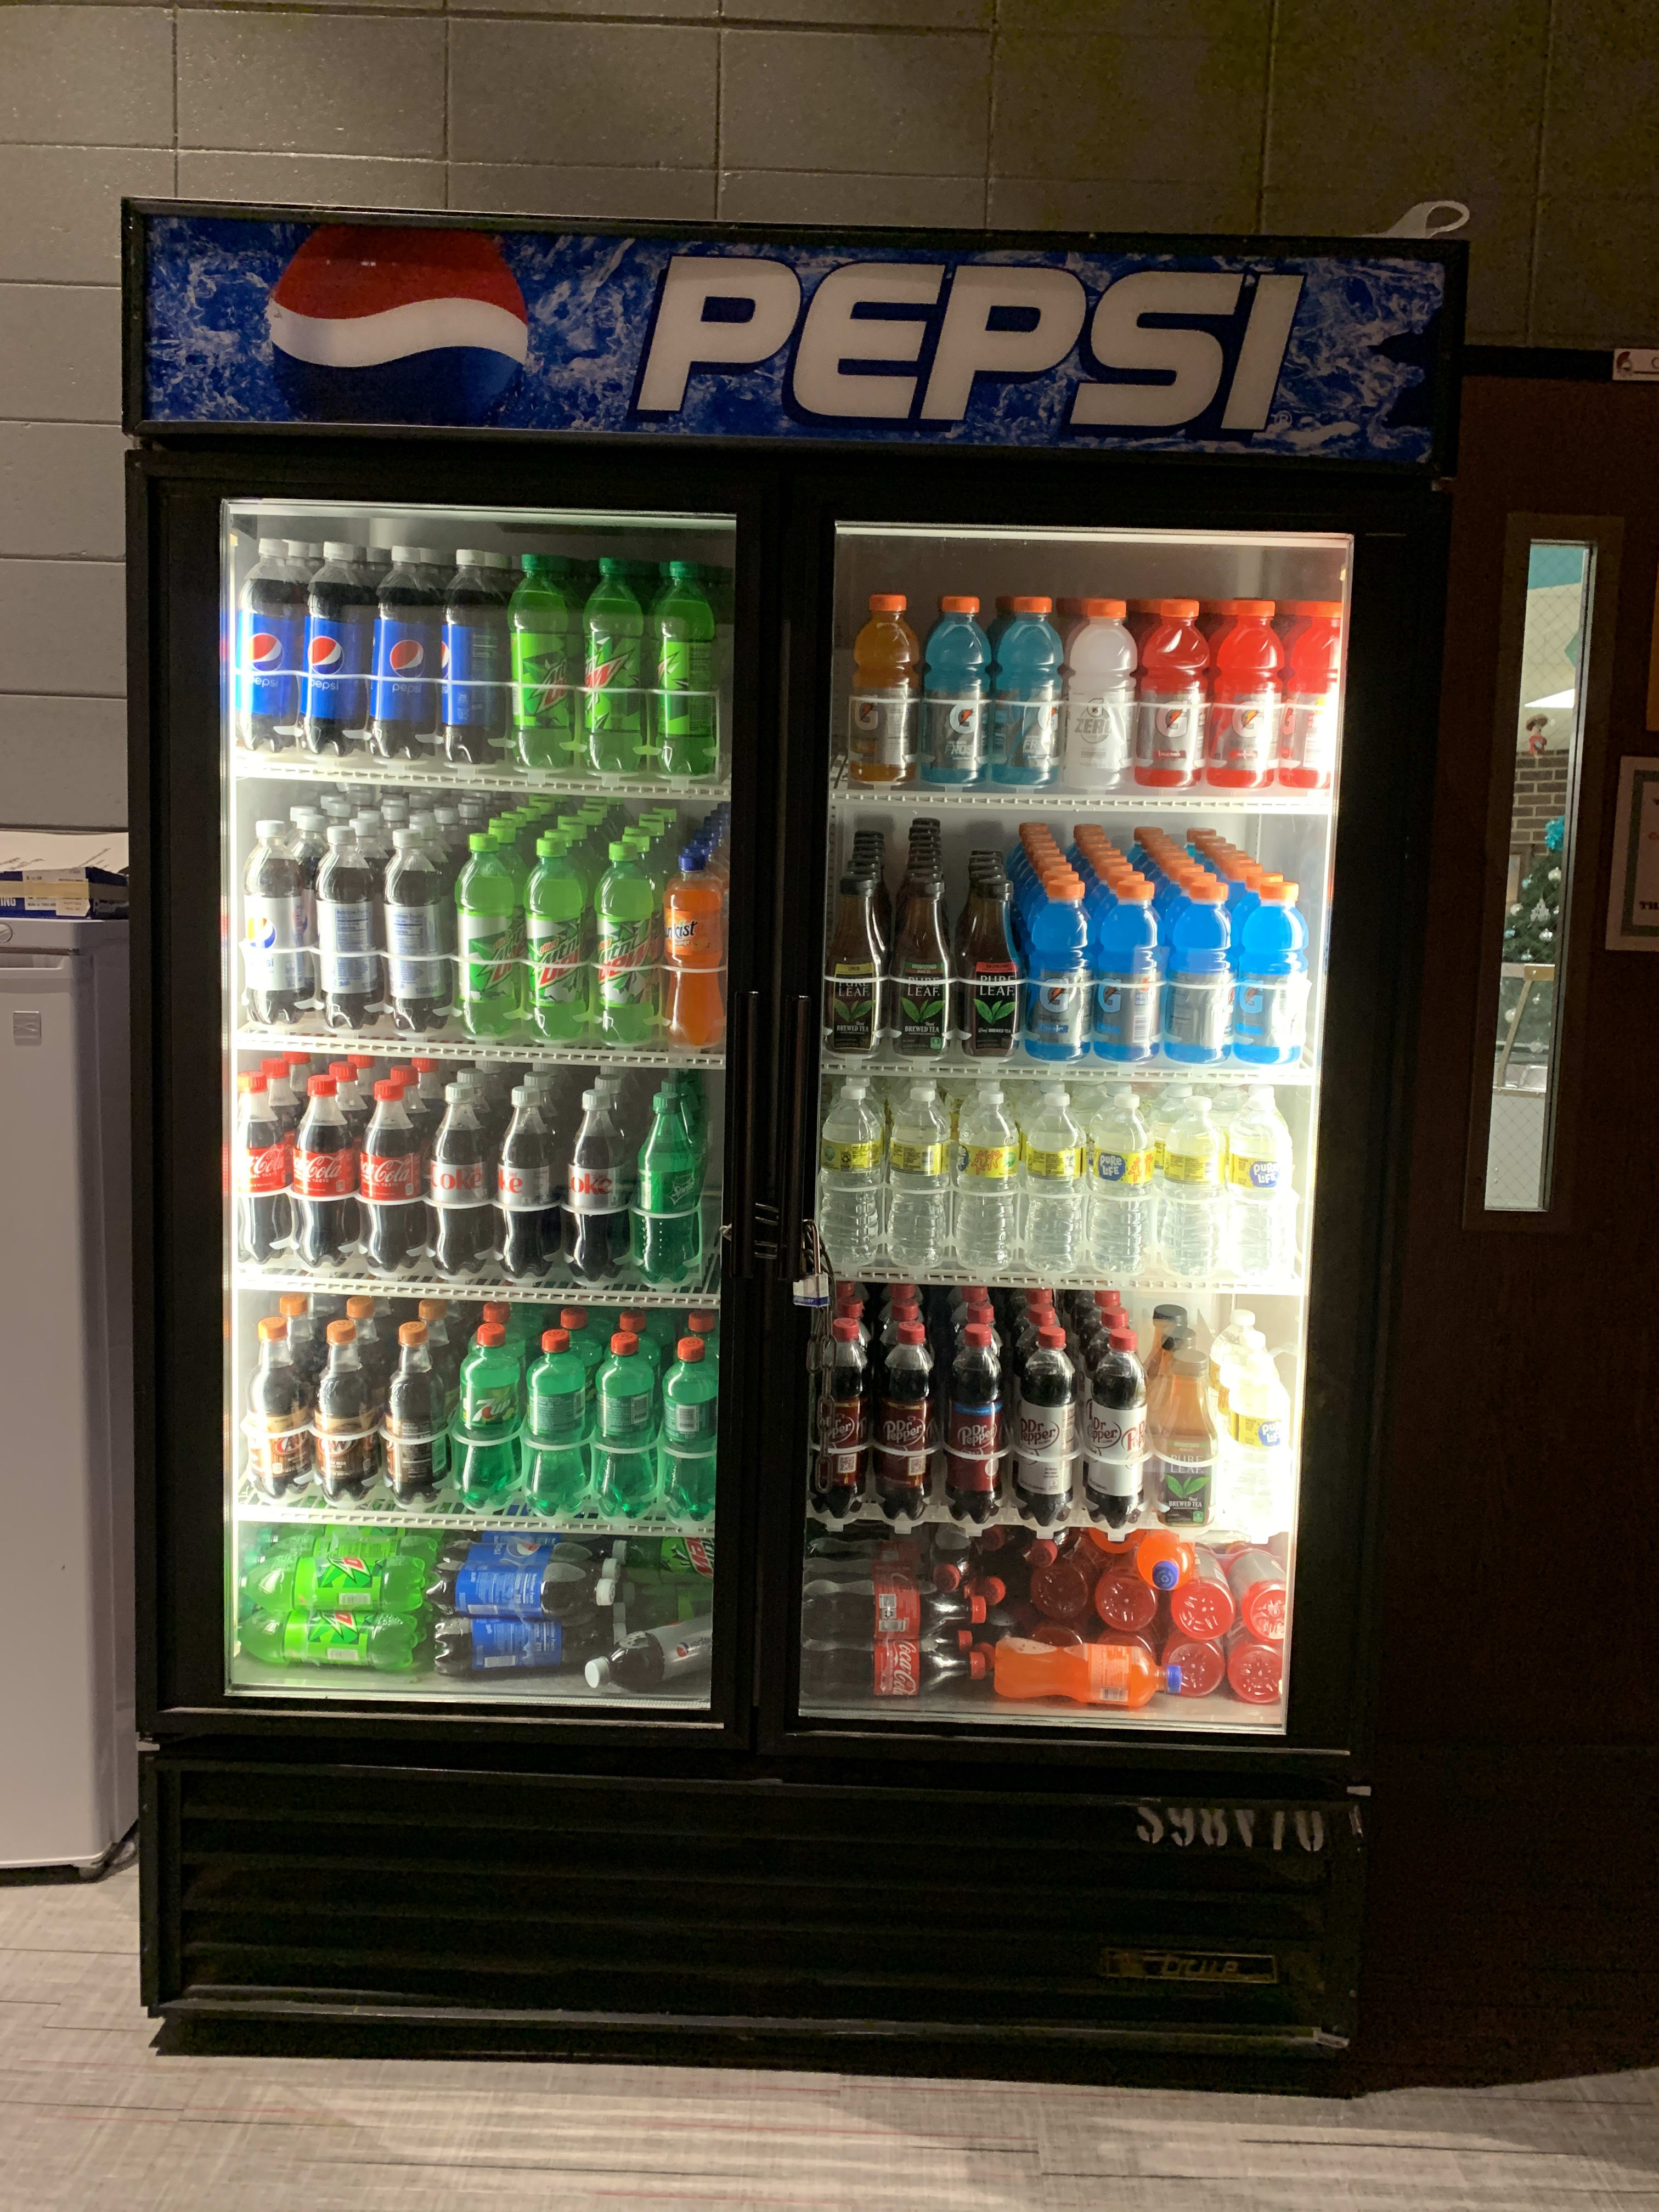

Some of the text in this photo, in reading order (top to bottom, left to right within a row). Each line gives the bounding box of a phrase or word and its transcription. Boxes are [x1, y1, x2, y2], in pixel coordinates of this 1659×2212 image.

[636, 256, 1307, 432] PEPSI
[249, 677, 278, 688] epsi
[839, 988, 870, 997] LEAF
[908, 987, 938, 997] LEAF
[980, 986, 1013, 996] LEAF
[498, 1169, 523, 1194] ke
[571, 1173, 612, 1195] oke
[896, 1420, 912, 1431] Dr
[974, 1425, 988, 1436] Dr
[1028, 1420, 1044, 1432] Dr
[885, 1420, 923, 1443] Pepper
